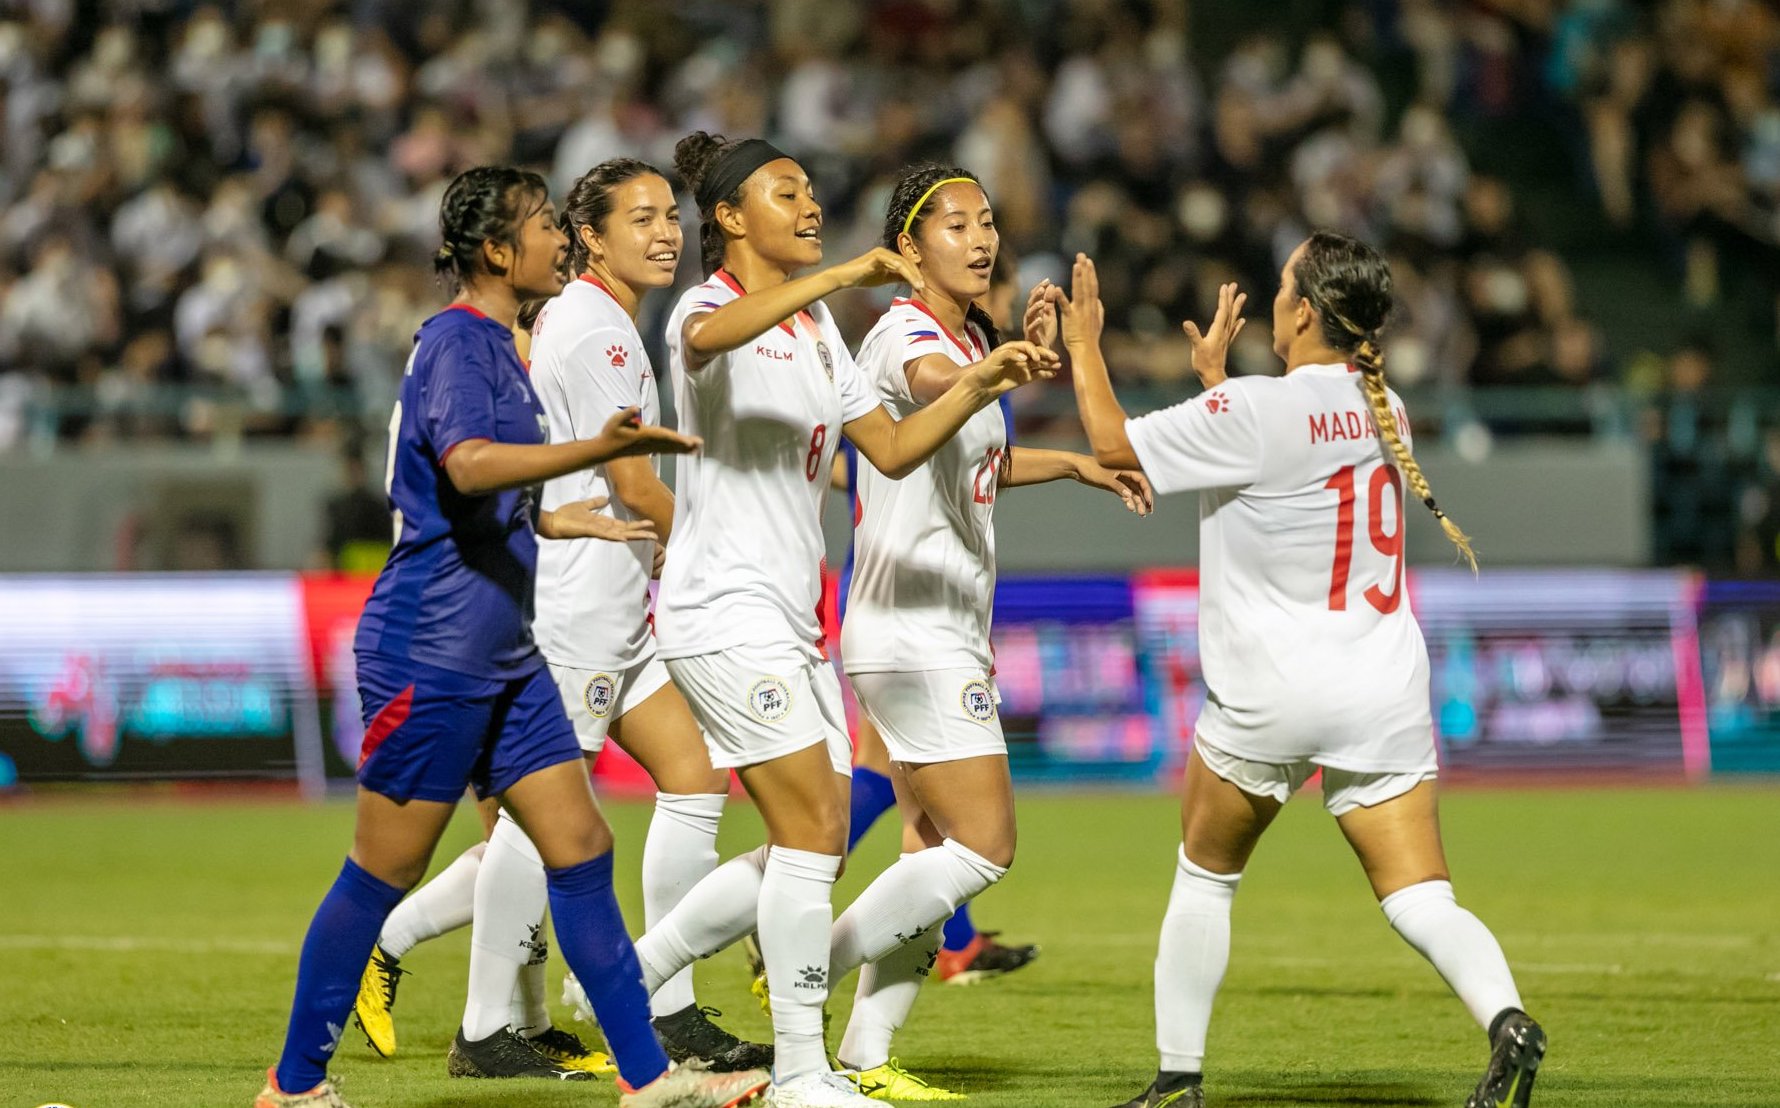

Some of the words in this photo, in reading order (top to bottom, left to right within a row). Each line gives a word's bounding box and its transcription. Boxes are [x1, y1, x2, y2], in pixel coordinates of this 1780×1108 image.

[1308, 406, 1412, 444] MADAN
[806, 424, 826, 482] 8
[1324, 464, 1404, 615] 19
[763, 699, 782, 712] PFF
[974, 704, 989, 712] PFF
